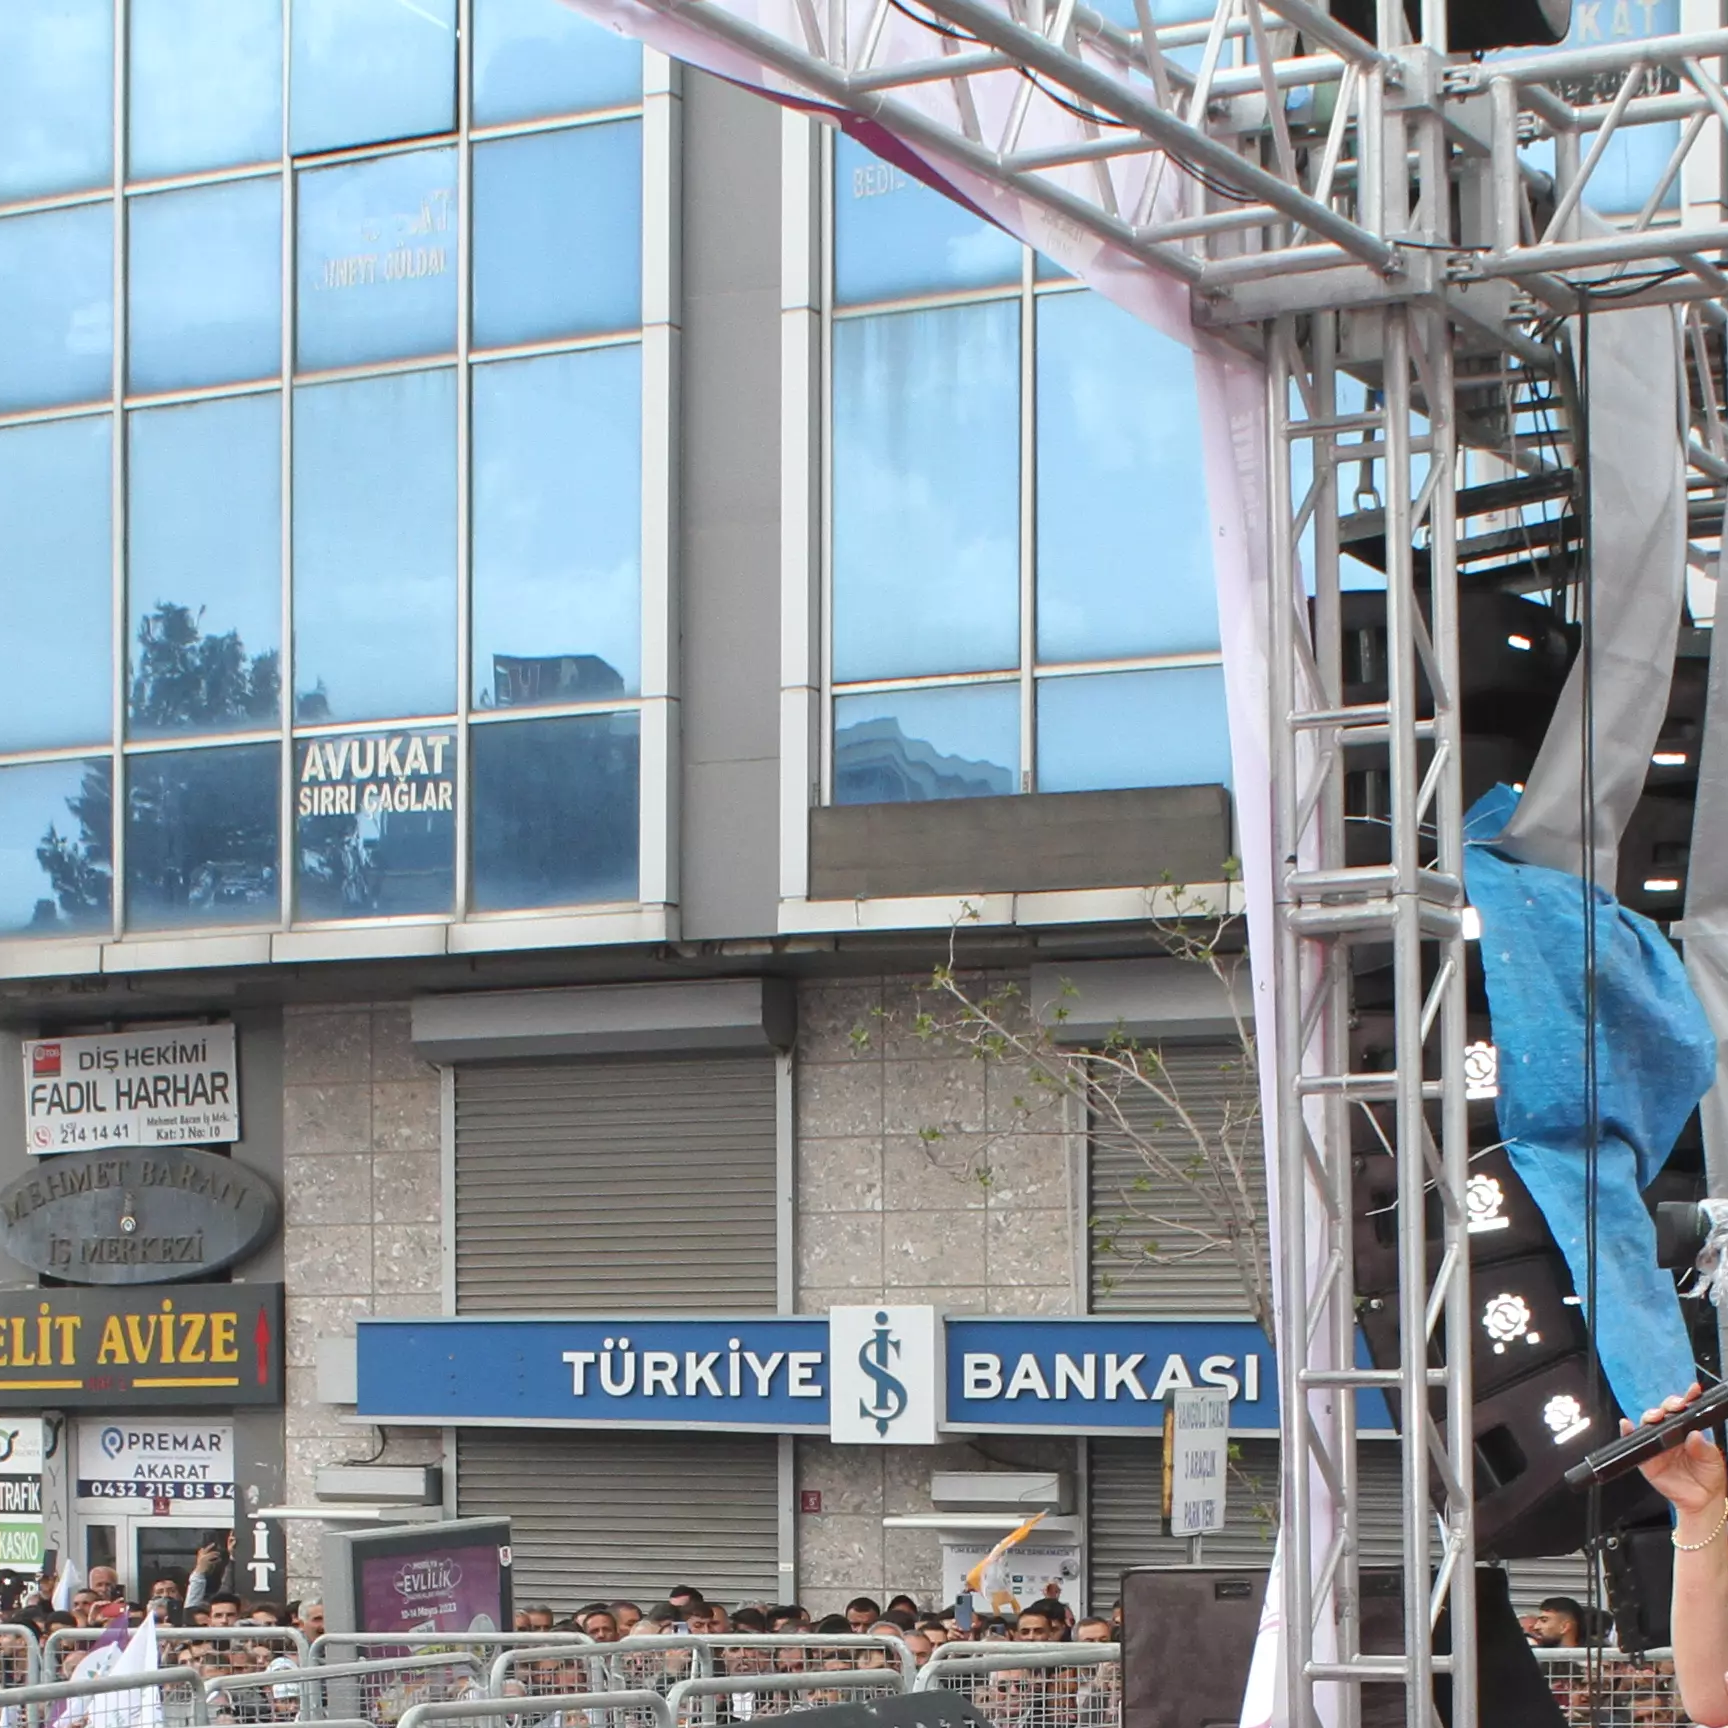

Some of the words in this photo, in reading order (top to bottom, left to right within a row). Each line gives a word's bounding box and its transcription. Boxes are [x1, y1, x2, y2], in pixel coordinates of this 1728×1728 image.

[300, 735, 450, 783] AVUKAT
[298, 784, 356, 817] SIRRI
[363, 777, 453, 818] ÇAĞLAR
[79, 1046, 119, 1073] DİŞ
[125, 1039, 207, 1067] HEKİMİ
[31, 1080, 106, 1116] FADIL
[116, 1072, 230, 1111] HARHAR
[60, 1128, 86, 1144] 214
[93, 1126, 108, 1141] 14
[113, 1124, 129, 1139] 41
[156, 1129, 176, 1140] Kat:
[189, 1125, 206, 1138] No:
[209, 1124, 221, 1137] 10
[2, 1161, 130, 1226] MEHMET
[141, 1159, 249, 1211] BARAN
[49, 1233, 71, 1272] İŞ
[79, 1229, 204, 1265] MERKEZİ
[97, 1299, 239, 1364] AVİZE
[562, 1337, 823, 1397] TÜRKİYE
[963, 1353, 1259, 1401] BANKASI
[128, 1430, 221, 1451] PREMAR
[134, 1464, 210, 1480] AKARAT
[91, 1483, 137, 1497] 0432
[145, 1482, 174, 1498] 215
[183, 1483, 205, 1498] 85
[213, 1482, 235, 1498] 94
[0, 1531, 39, 1561] KASKO
[403, 1568, 453, 1592] EVLİLİK
